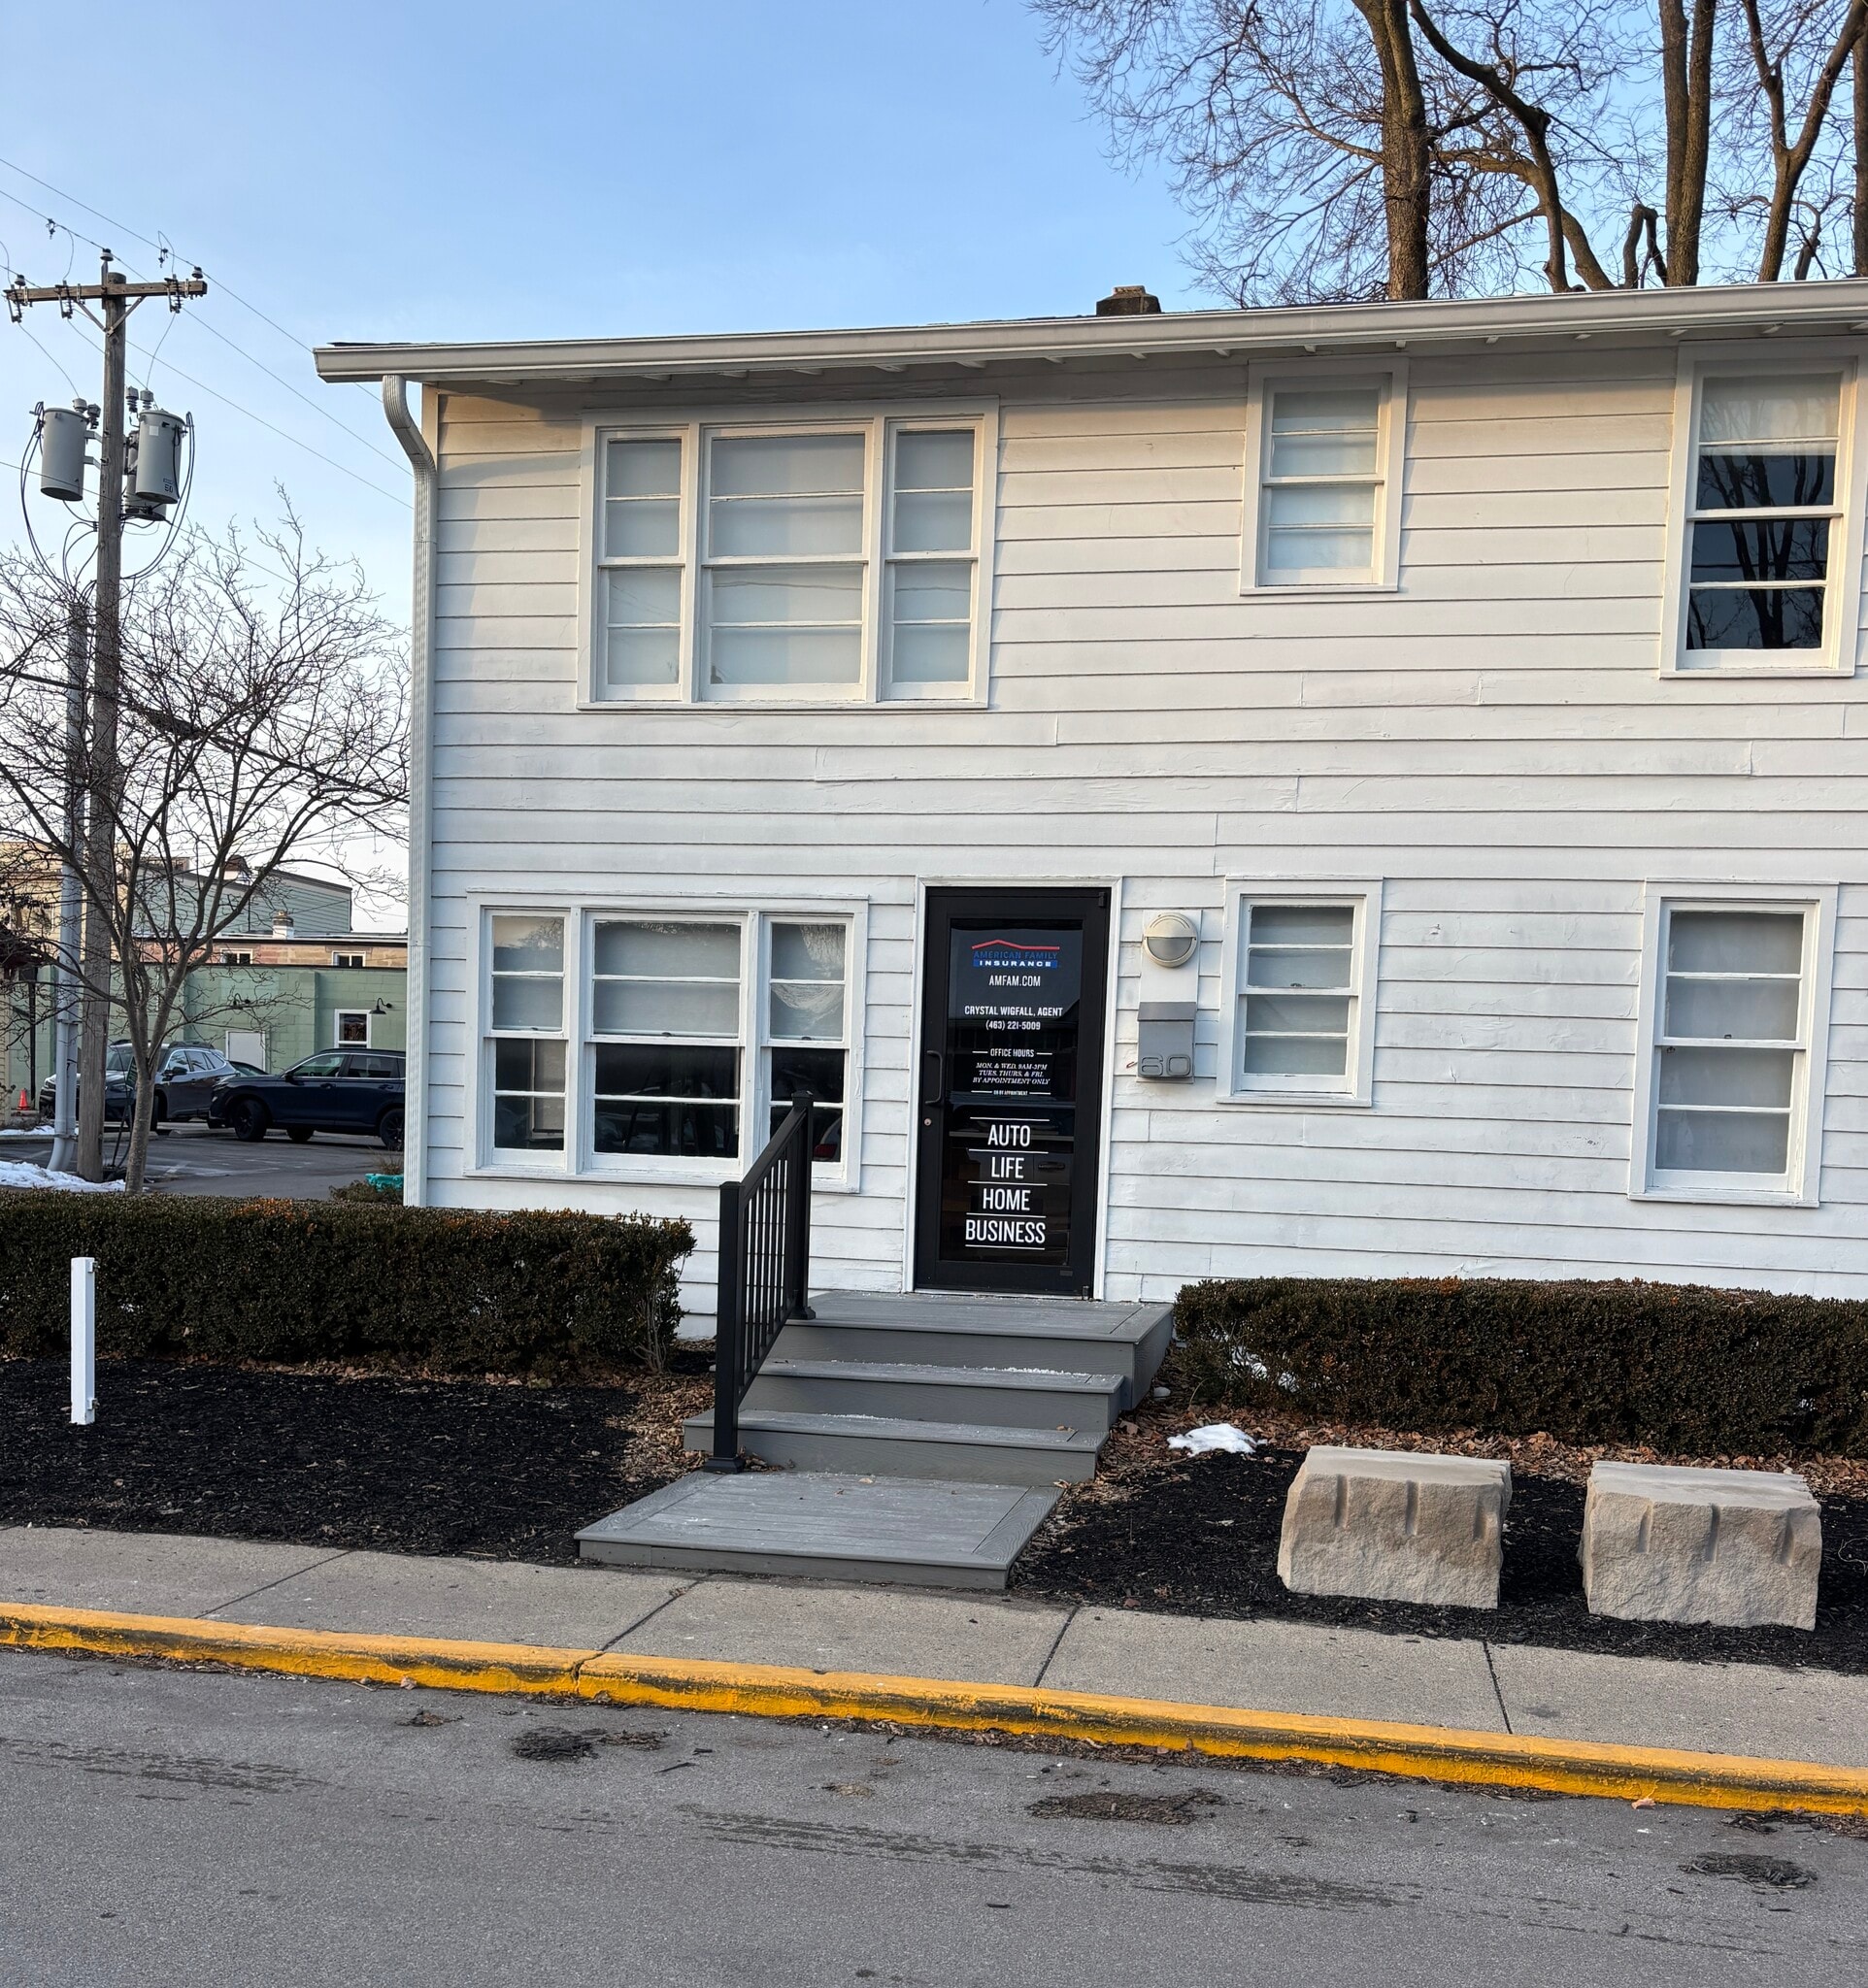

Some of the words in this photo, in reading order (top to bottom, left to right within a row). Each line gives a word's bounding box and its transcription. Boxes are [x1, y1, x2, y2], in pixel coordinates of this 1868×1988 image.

[1025, 951, 1057, 960] FAMILY
[988, 975, 1041, 987] AMFAM.COM
[964, 1005, 999, 1015] CRYSTAL
[1000, 1006, 1036, 1017] WIGFALL,
[1037, 1007, 1063, 1017] AGENT
[985, 1019, 1006, 1031] (463)
[1007, 1020, 1041, 1031] 221-5009
[990, 1047, 1013, 1057] OFFICE
[1013, 1048, 1035, 1058] HOURS
[1140, 1054, 1191, 1077] 60
[987, 1124, 1031, 1146] AUTO
[991, 1156, 1025, 1178] LIFE
[983, 1187, 1031, 1211] HOME
[965, 1219, 1047, 1243] BUSINESS
